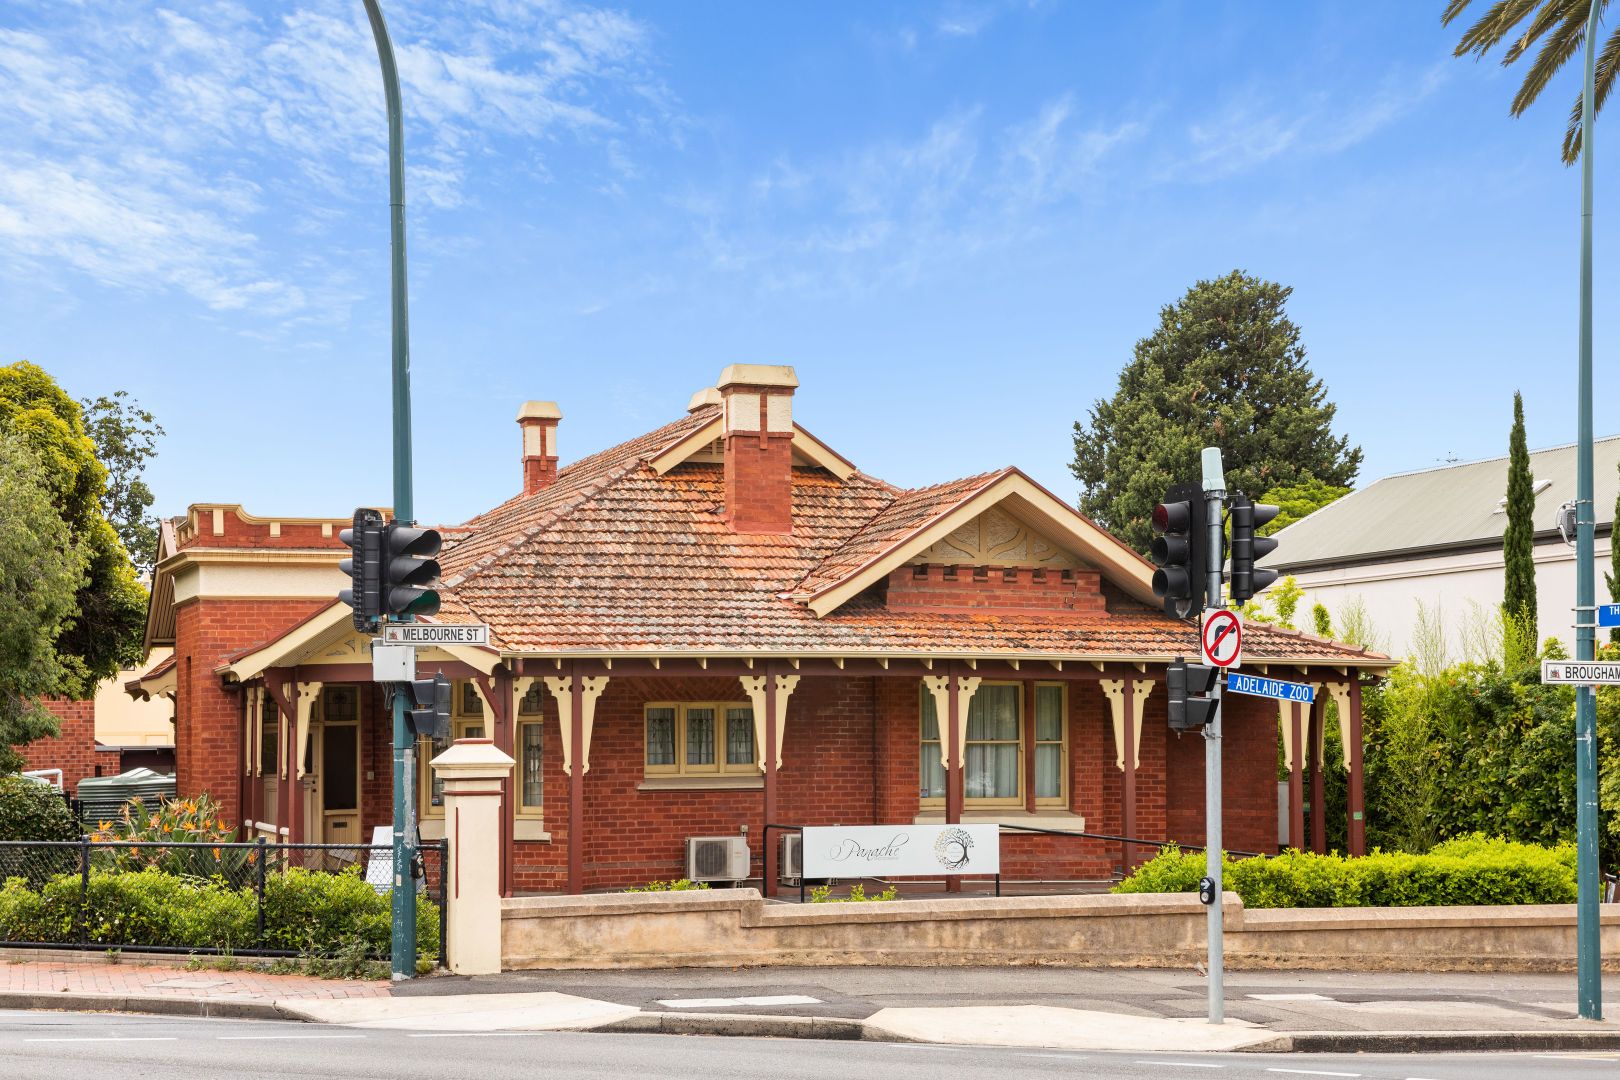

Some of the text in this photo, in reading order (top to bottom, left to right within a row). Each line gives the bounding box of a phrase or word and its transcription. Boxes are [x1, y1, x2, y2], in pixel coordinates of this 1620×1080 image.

[403, 628, 479, 641] MELBOURNE ST
[1235, 676, 1309, 701] ADELAIDE ZOO
[829, 833, 910, 862] Panache
